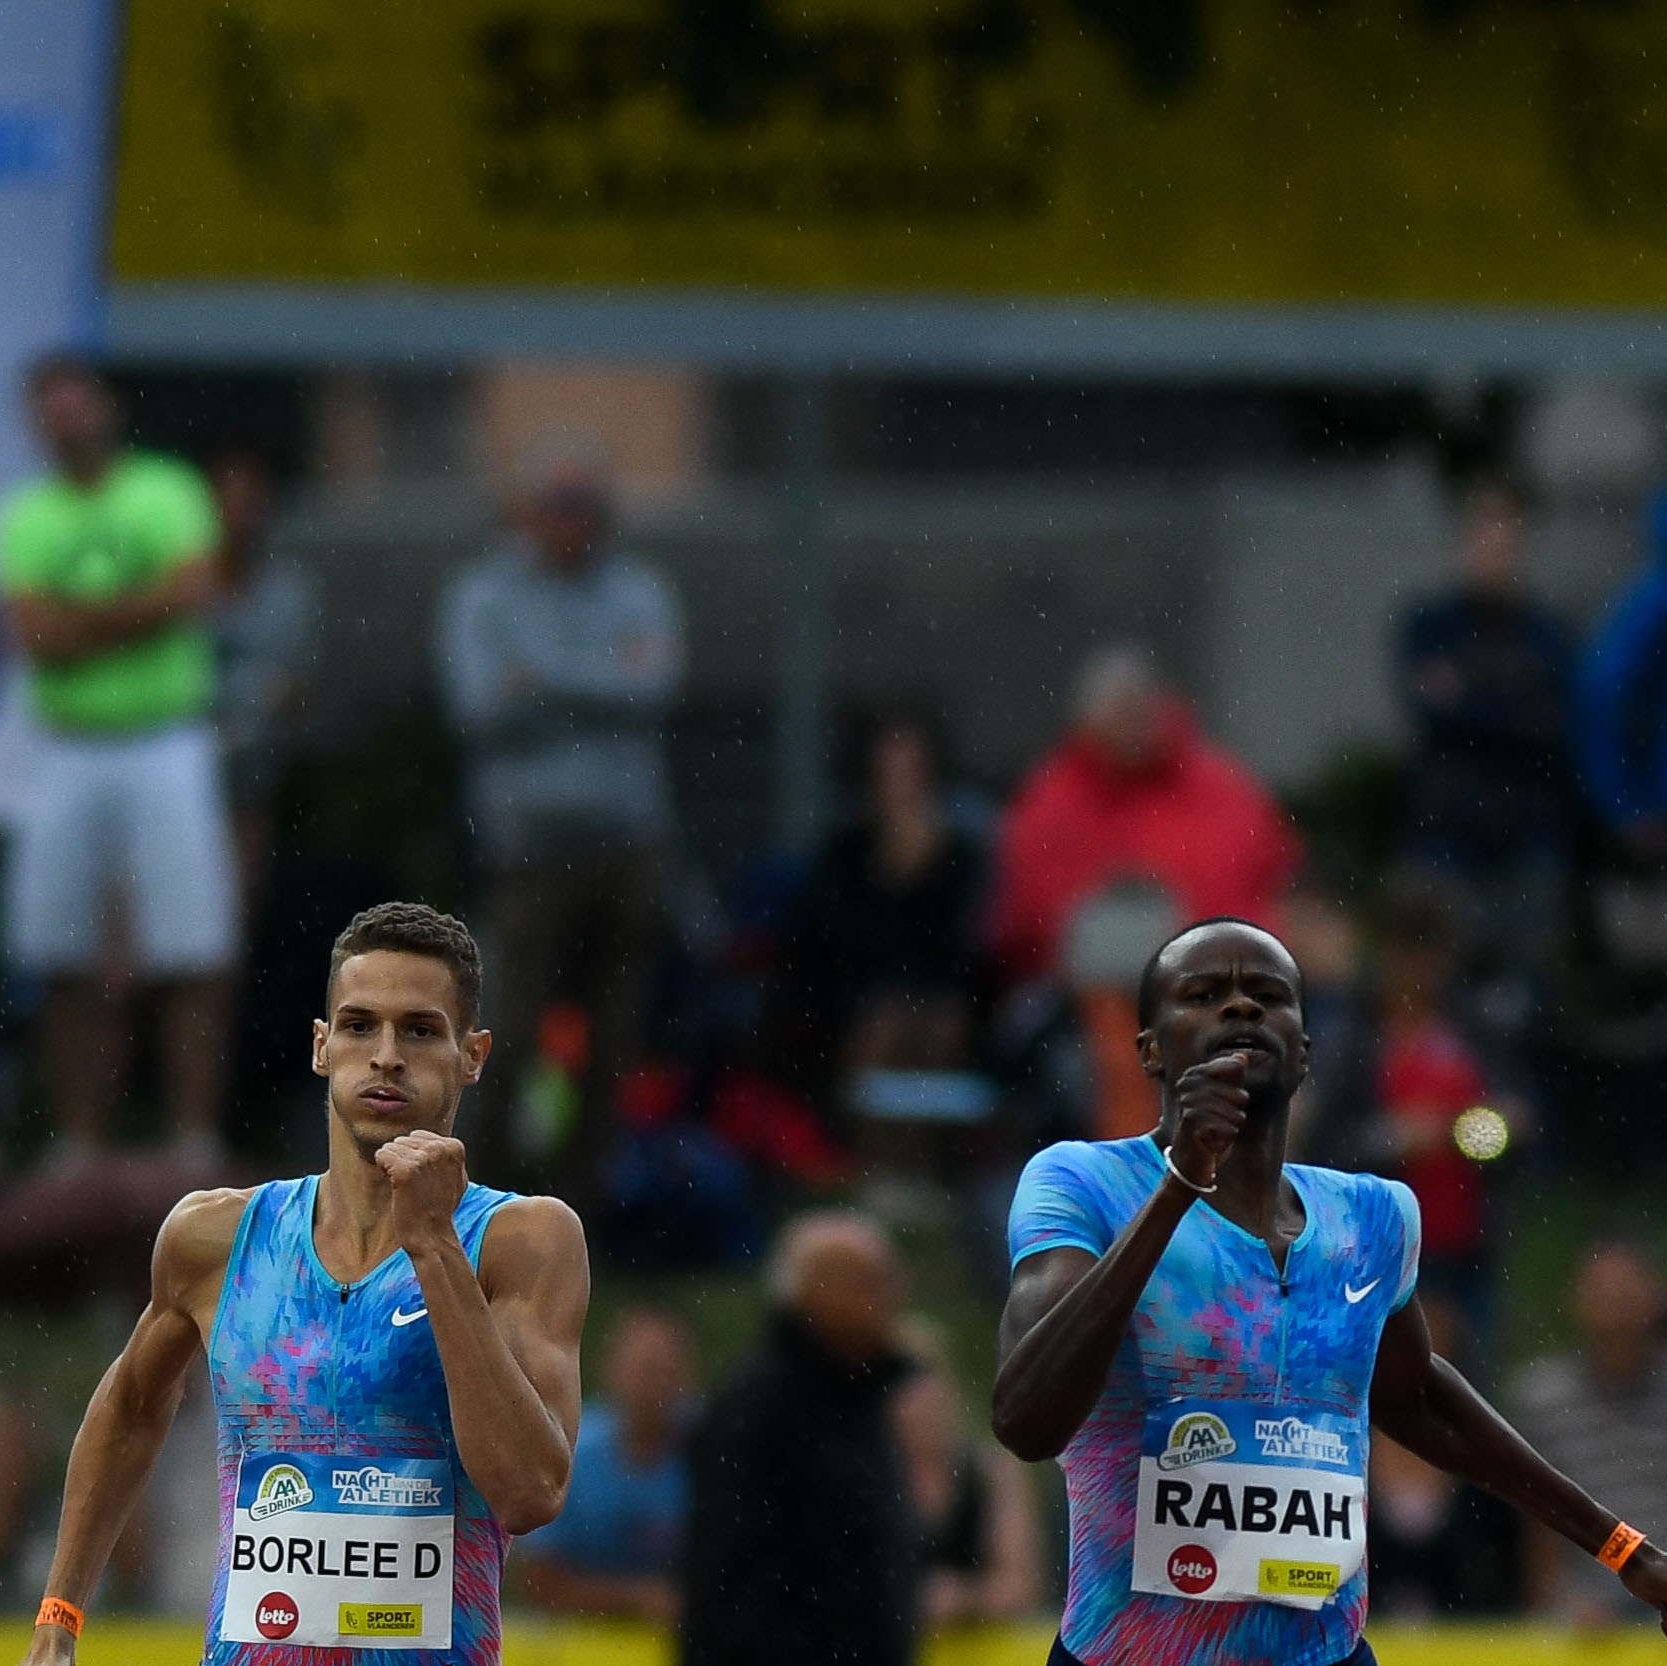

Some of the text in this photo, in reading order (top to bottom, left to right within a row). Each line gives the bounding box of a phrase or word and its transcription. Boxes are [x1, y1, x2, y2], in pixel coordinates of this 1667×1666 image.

[1188, 1428, 1215, 1449] AA
[1181, 1445, 1224, 1464] DRINK
[1264, 1440, 1346, 1462] ATLETIEK
[273, 1478, 297, 1501] AA
[342, 1488, 439, 1504] ATLETIEK
[268, 1496, 302, 1514] DRINK
[1154, 1479, 1352, 1541] RABAH
[232, 1534, 441, 1579] BORLEE D
[367, 1612, 415, 1623] SPORT.
